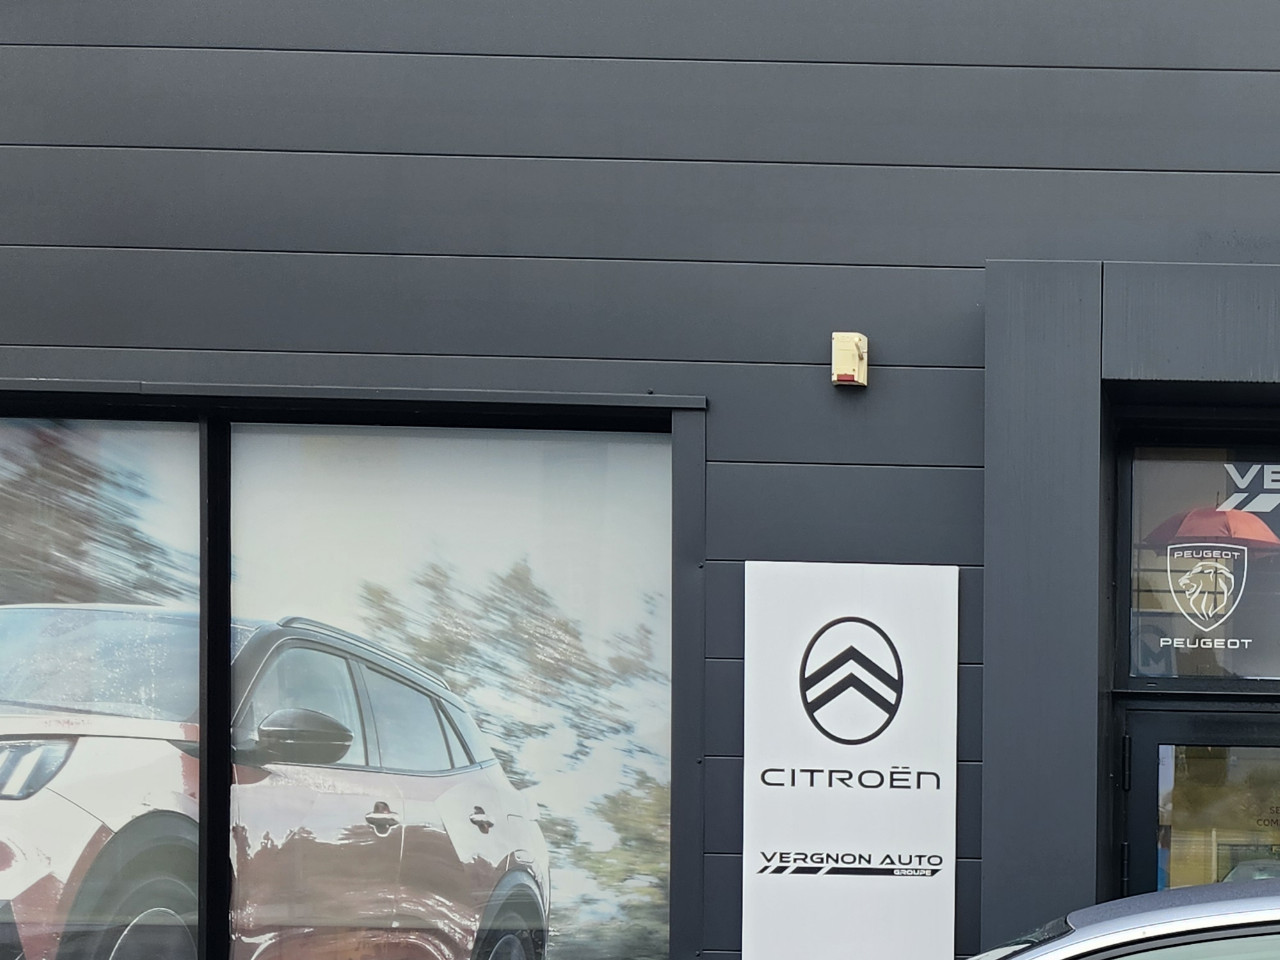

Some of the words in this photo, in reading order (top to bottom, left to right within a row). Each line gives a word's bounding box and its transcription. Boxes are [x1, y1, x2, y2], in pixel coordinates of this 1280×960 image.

[1174, 550, 1240, 560] PEUGEOT
[1160, 638, 1252, 650] PEUGEOT
[760, 852, 871, 865] VERGNON
[879, 854, 943, 867] AUTO
